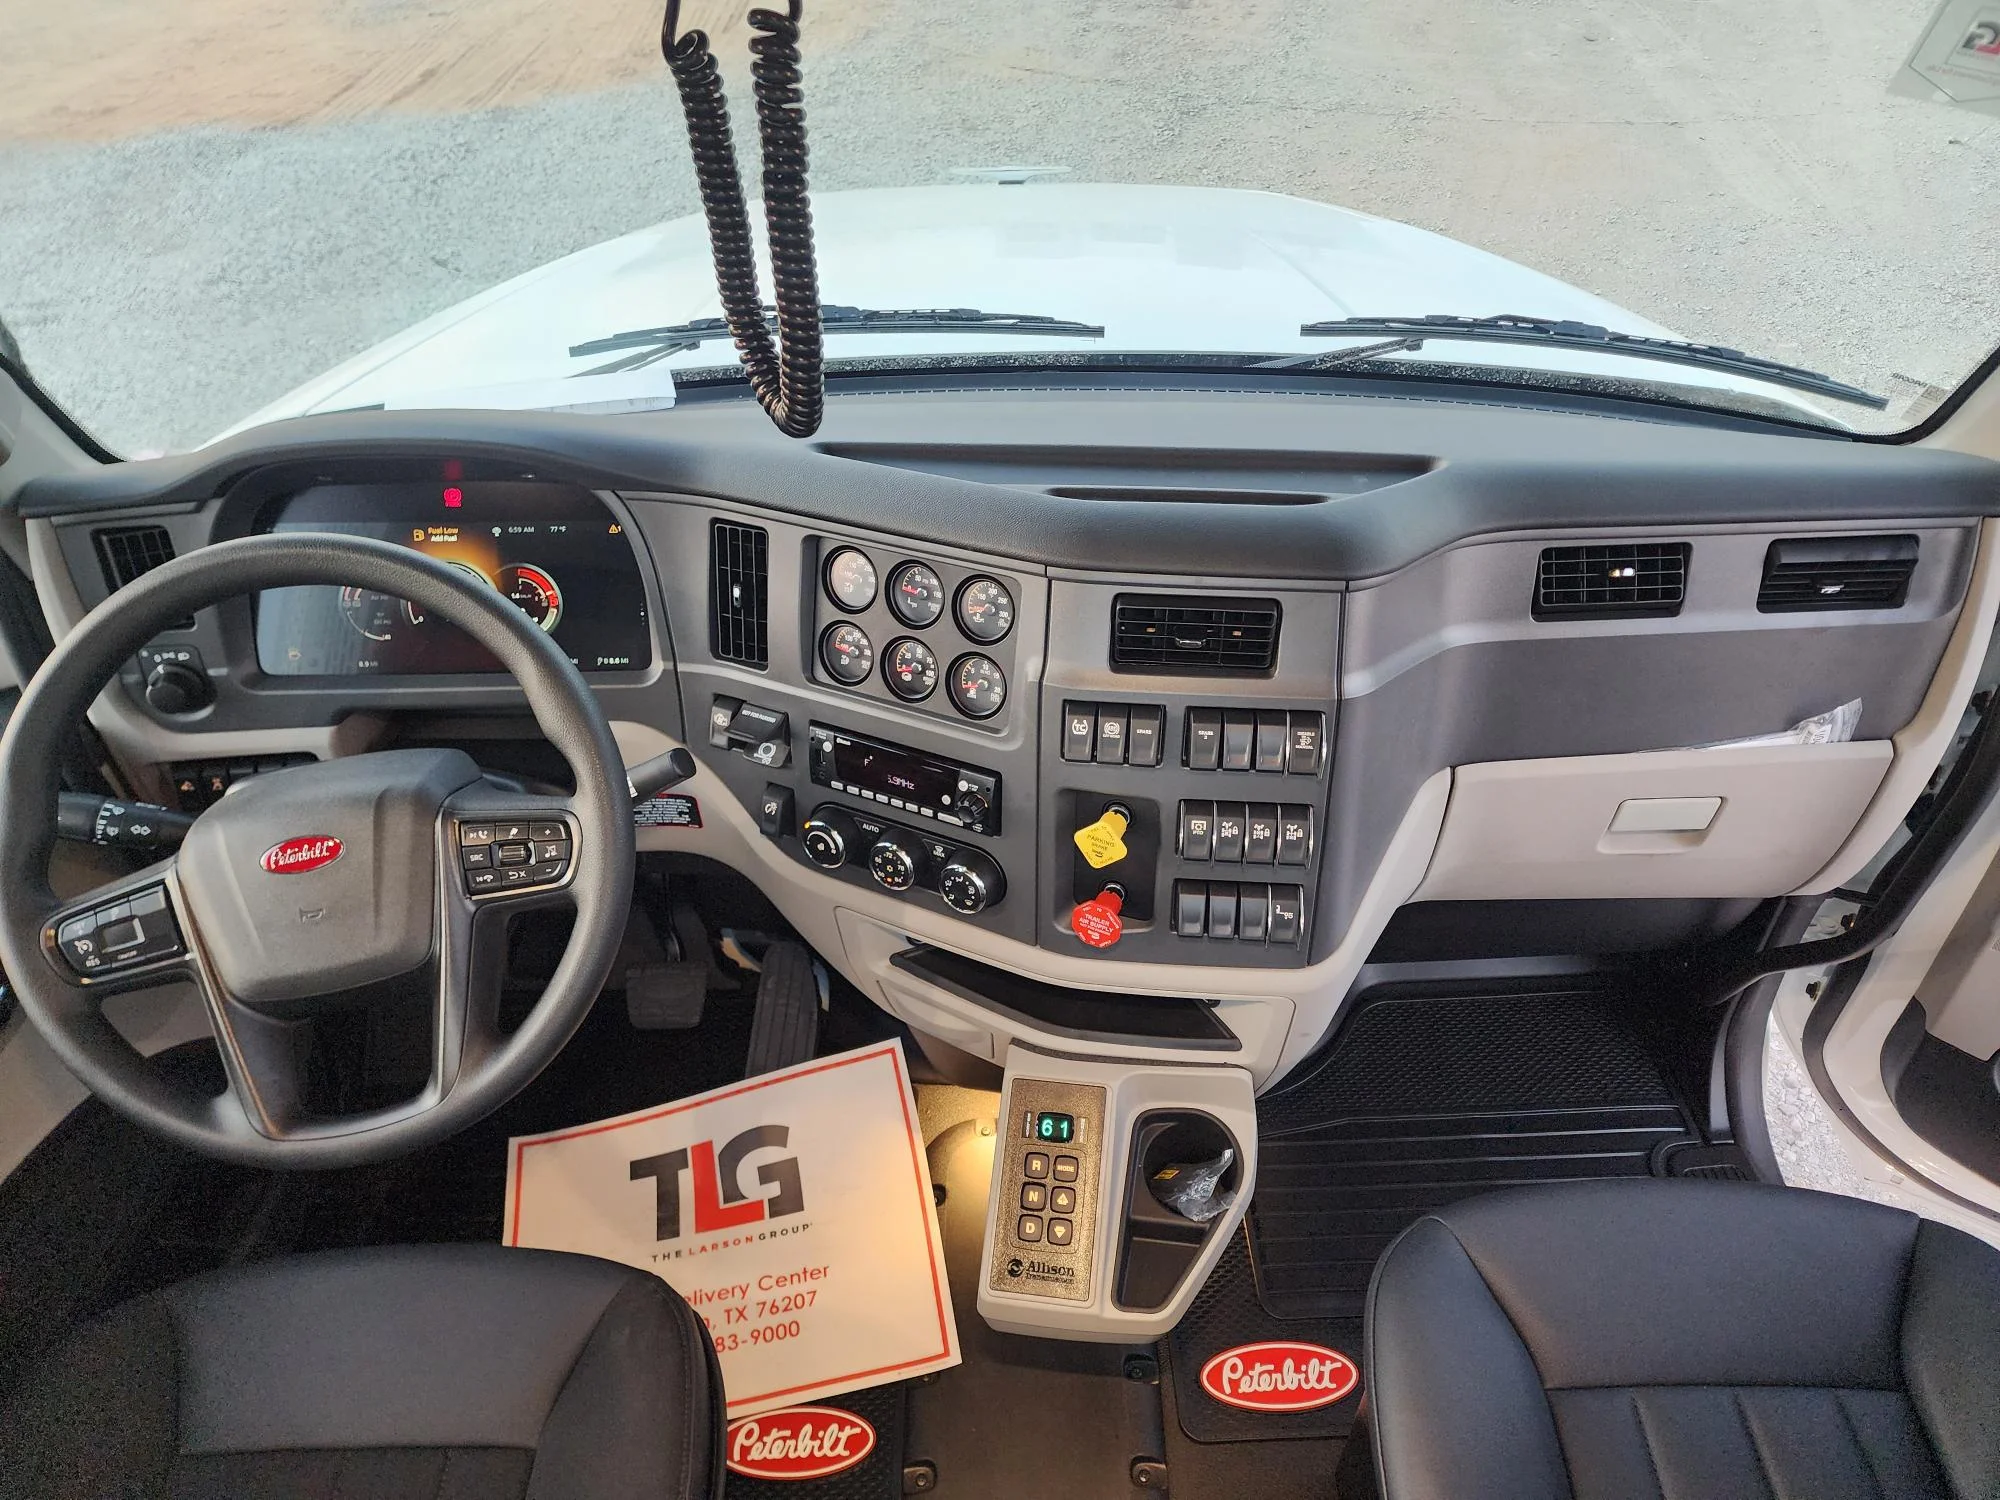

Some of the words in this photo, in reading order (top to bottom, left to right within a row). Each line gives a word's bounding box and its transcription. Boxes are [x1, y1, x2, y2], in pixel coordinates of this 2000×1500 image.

[1074, 723, 1086, 732] TC
[862, 823, 880, 834] AUTO
[1086, 834, 1115, 848] PARKING
[270, 840, 335, 870] Peterbilt
[1085, 913, 1110, 927] TRAILER
[1089, 921, 1114, 933] SUPPLY
[1041, 1117, 1069, 1139] 61
[1056, 1165, 1075, 1173] MODE
[629, 1124, 805, 1241] TLG
[1028, 1191, 1039, 1202] N
[1025, 1222, 1036, 1234] D
[651, 1249, 682, 1263] THE
[688, 1235, 754, 1256] LARSON
[758, 1223, 810, 1241] GROUP
[1026, 1260, 1075, 1277] Allison
[758, 1265, 830, 1292] Center
[724, 1305, 749, 1325] TX
[756, 1290, 817, 1319] 76207
[1222, 1356, 1342, 1395] Peterbilt
[733, 1421, 862, 1462] Peterbilt
